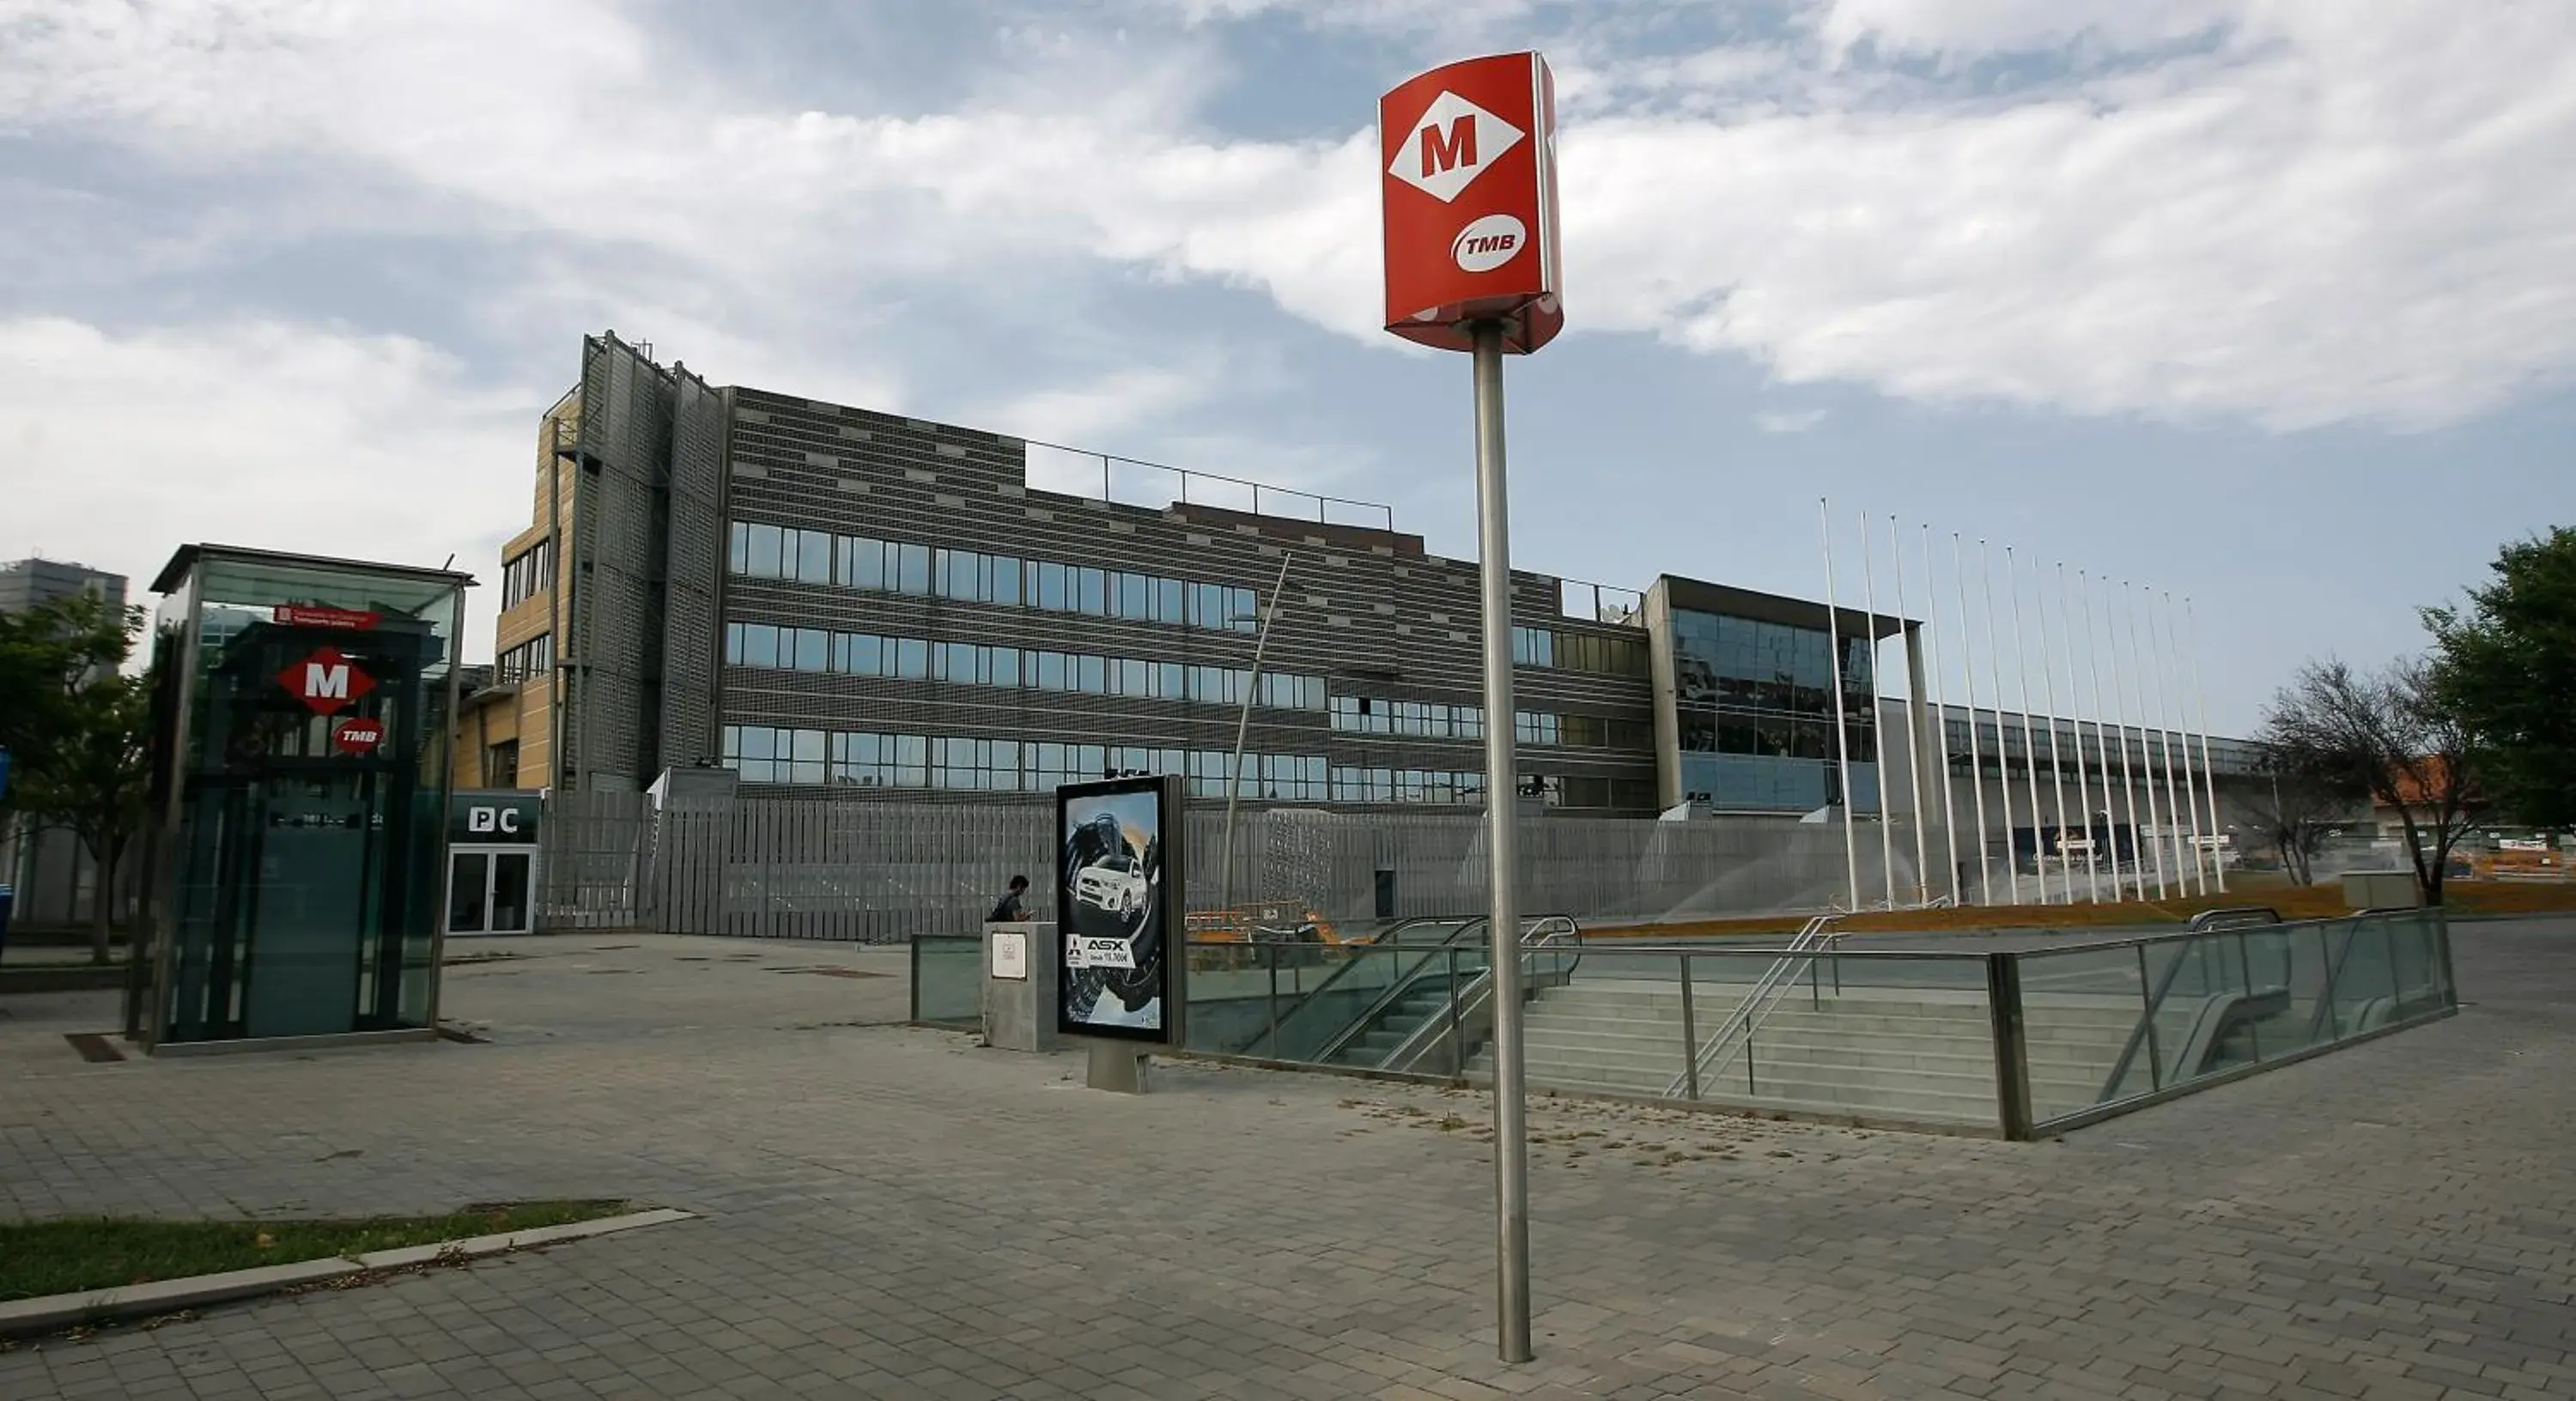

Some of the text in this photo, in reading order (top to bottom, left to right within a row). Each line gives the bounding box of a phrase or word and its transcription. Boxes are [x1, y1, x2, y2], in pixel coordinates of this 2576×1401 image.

[1421, 114, 1478, 179] M
[1466, 234, 1516, 255] TMB
[306, 663, 349, 698] M
[343, 731, 377, 743] TMB
[1087, 940, 1124, 951] ASX
